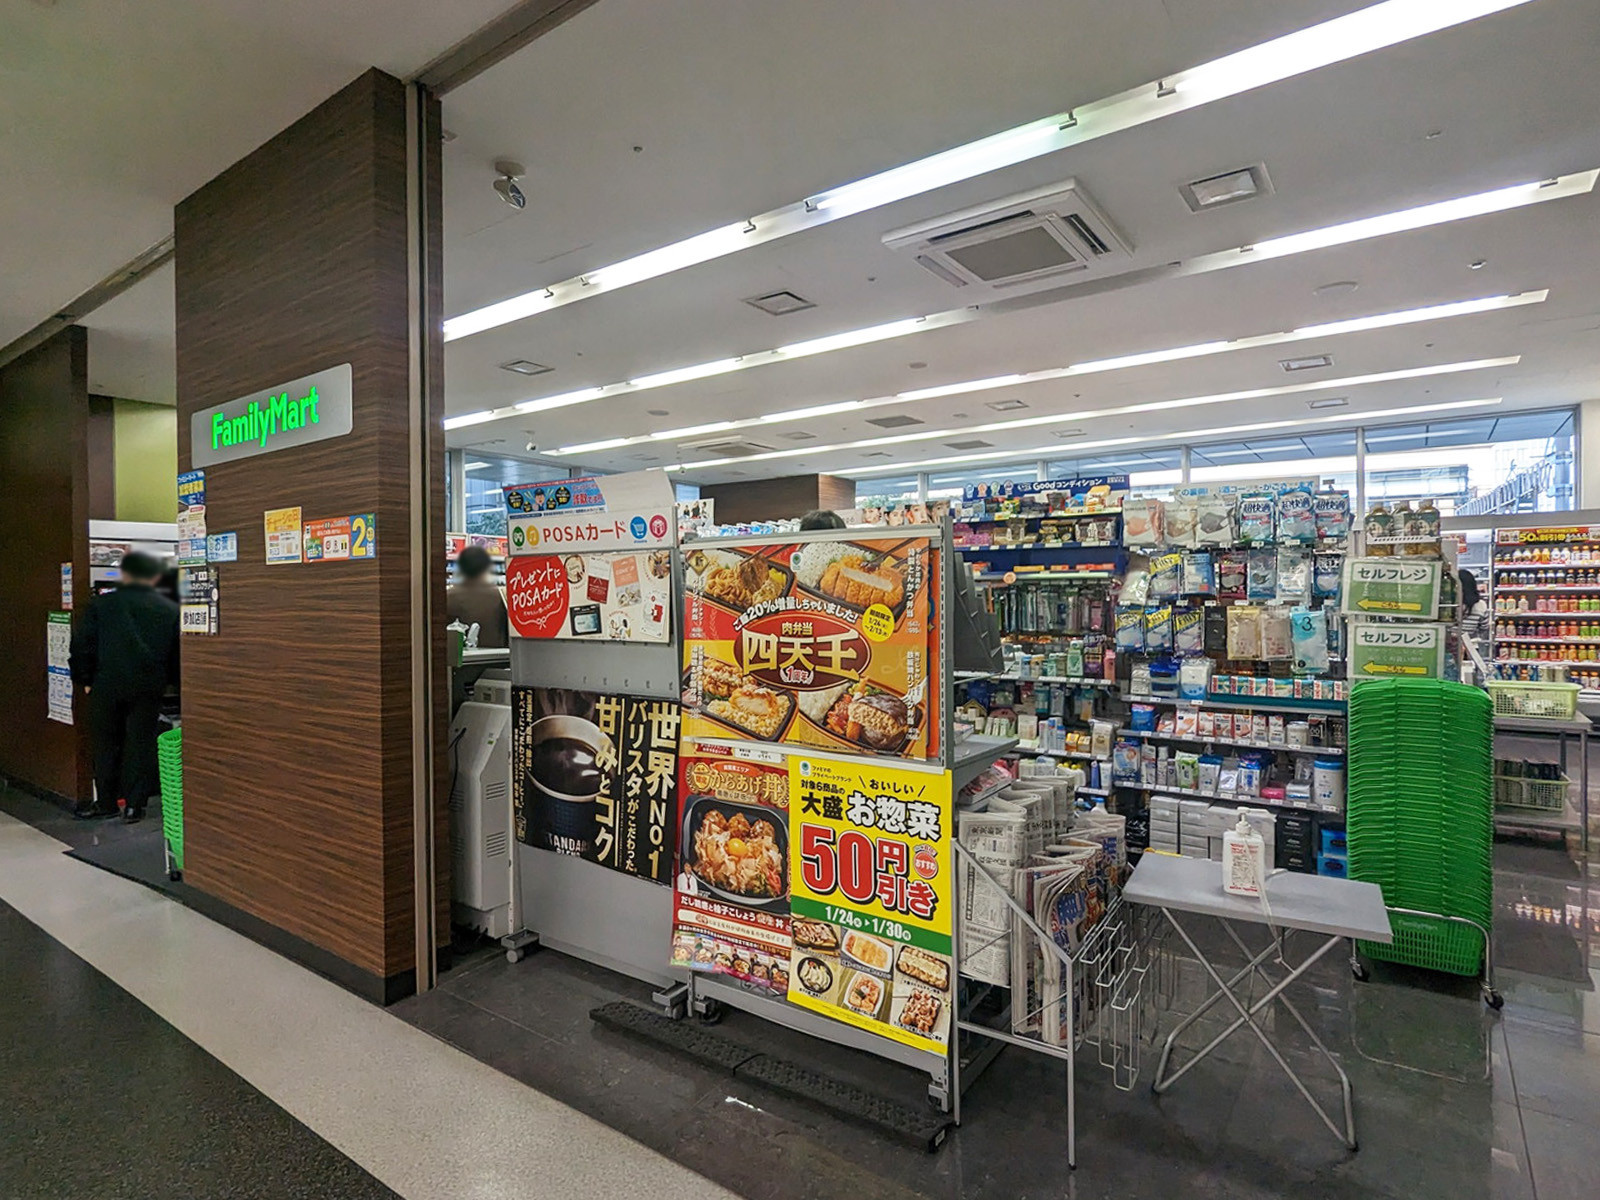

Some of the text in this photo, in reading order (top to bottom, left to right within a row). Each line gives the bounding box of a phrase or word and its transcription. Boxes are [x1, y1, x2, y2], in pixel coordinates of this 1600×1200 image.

[211, 386, 320, 450] FamilyMart
[1244, 503, 1271, 513] 超快適
[352, 517, 366, 557] 2
[543, 520, 627, 543] POSAカード
[509, 560, 561, 591] プレゼントに
[1358, 567, 1427, 581] セルフレジ
[512, 582, 564, 611] POSAカード
[781, 622, 813, 635] 肉弁当
[1301, 617, 1313, 631] 3
[1361, 632, 1431, 645] セルフレジ
[742, 627, 860, 683] 四天王
[594, 696, 622, 862] 甘みとコク
[712, 770, 782, 801] からあげ丼
[801, 779, 846, 795] 対象6商品の
[869, 778, 914, 794] おいしい
[801, 791, 843, 821] 大盛
[847, 790, 941, 842] お惣菜
